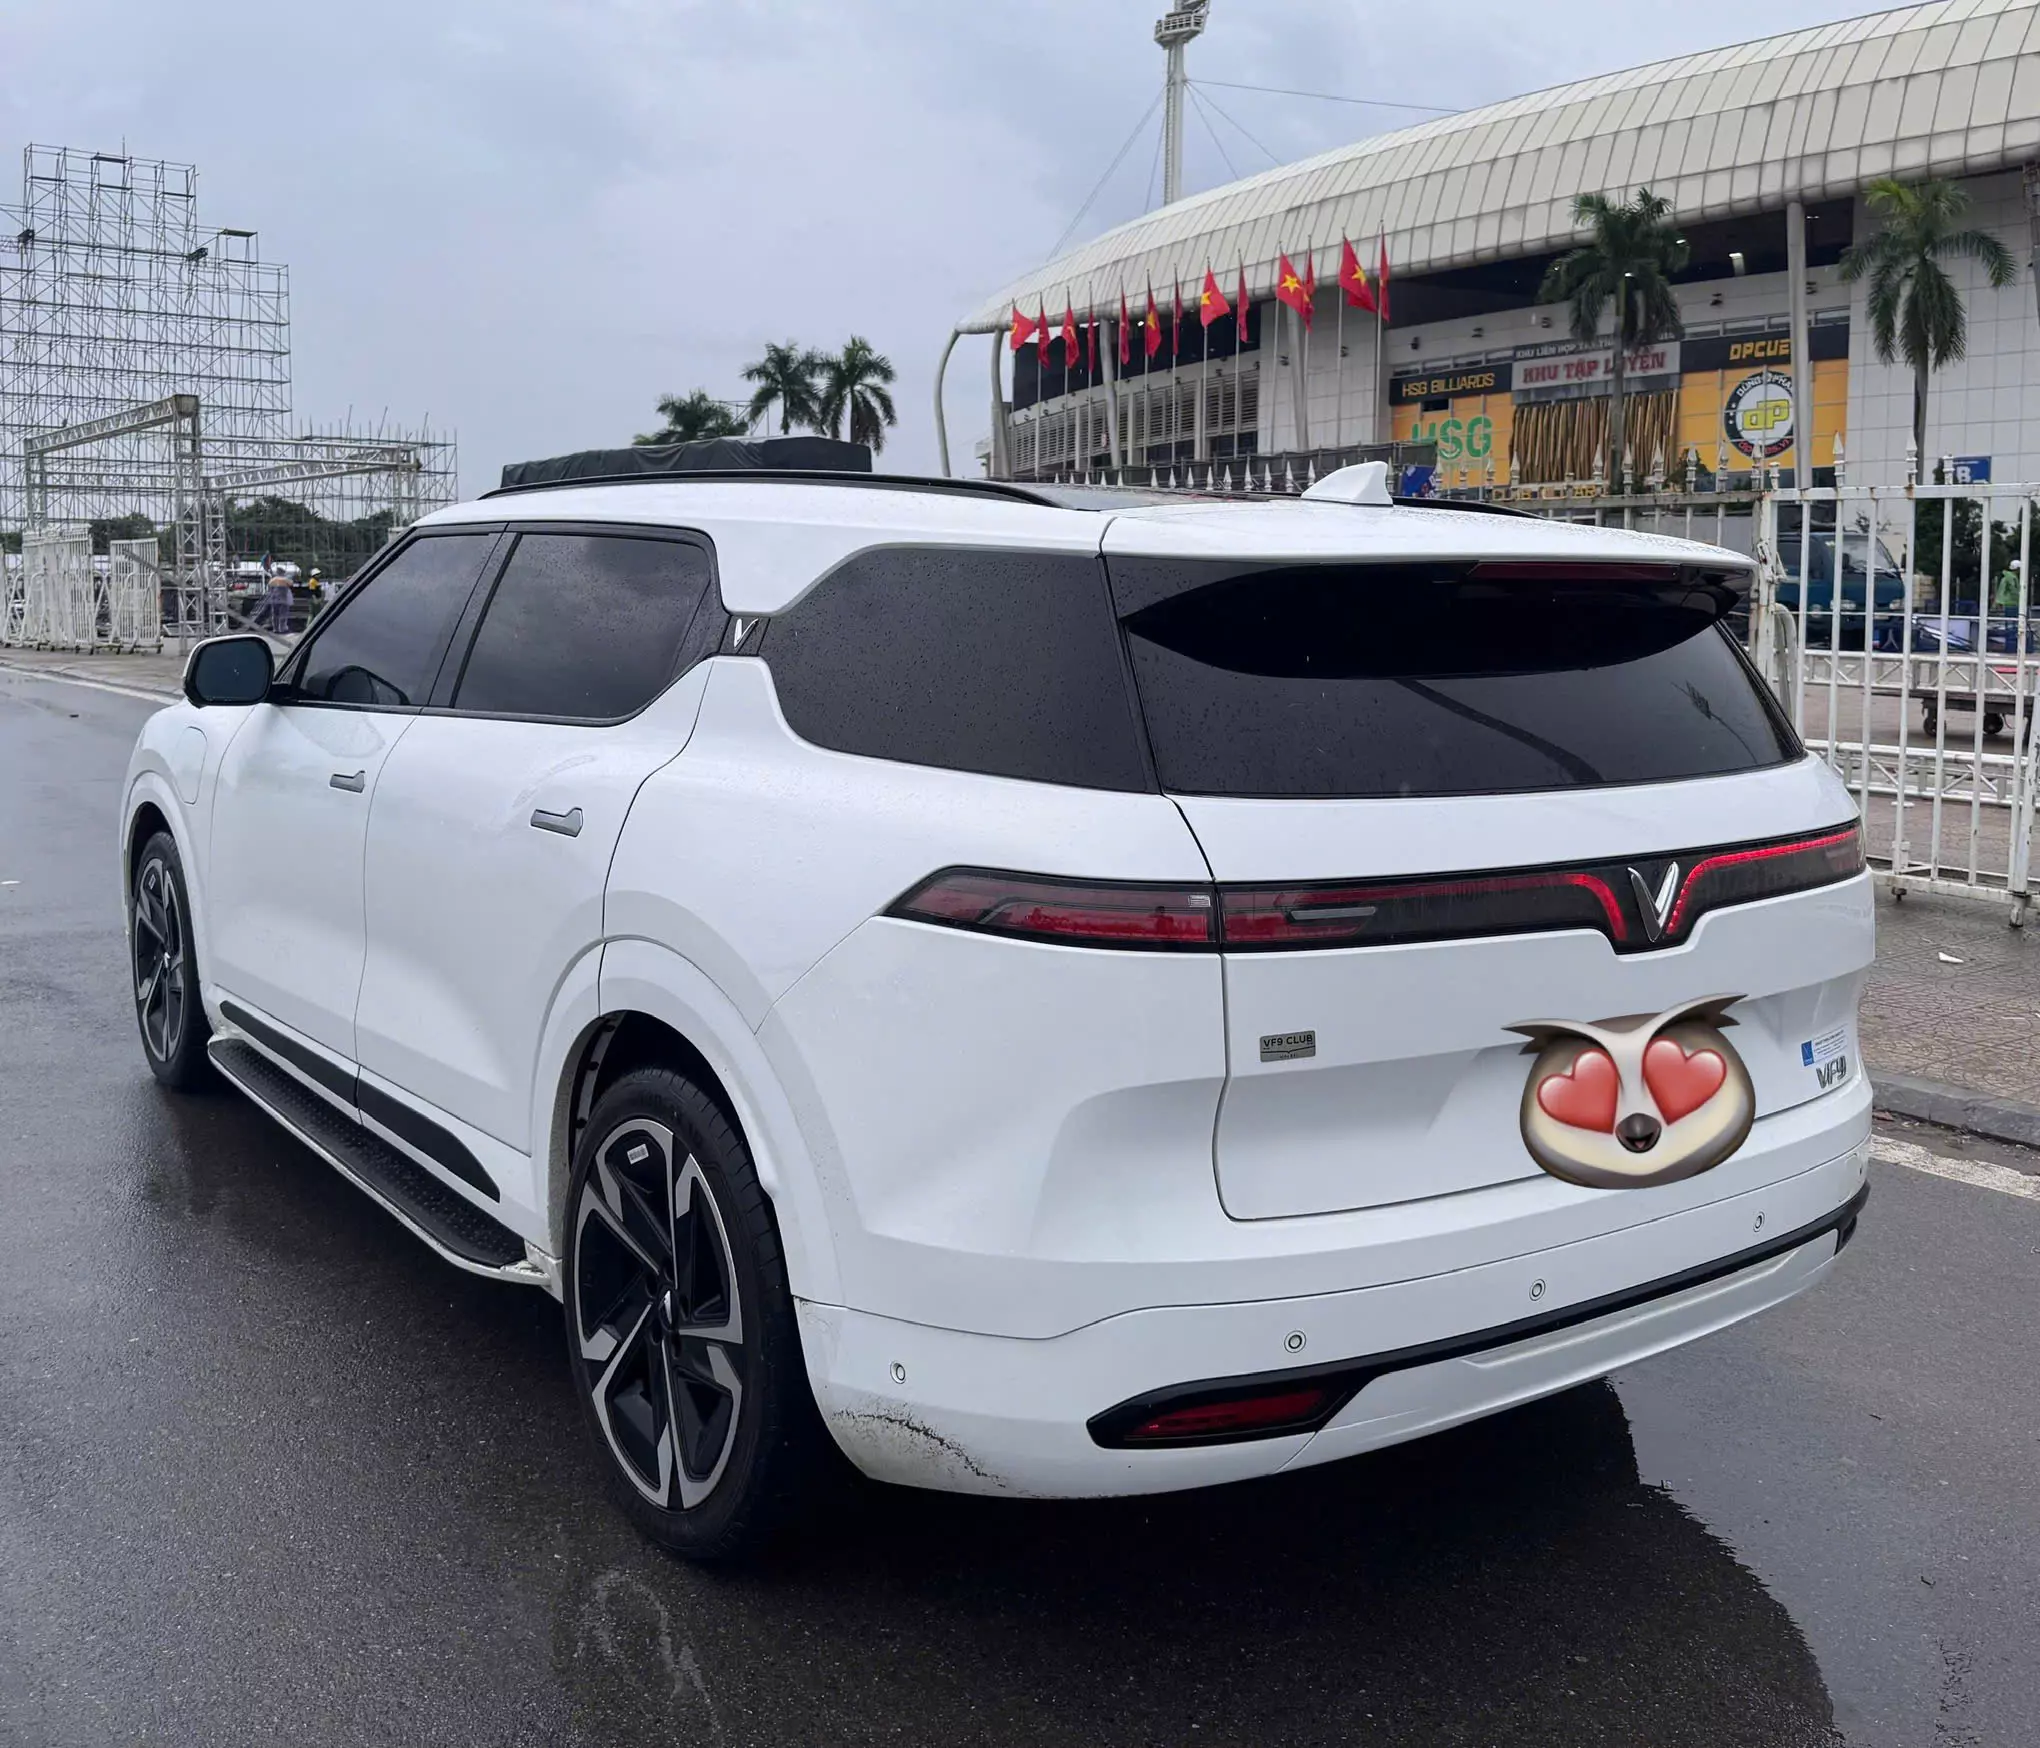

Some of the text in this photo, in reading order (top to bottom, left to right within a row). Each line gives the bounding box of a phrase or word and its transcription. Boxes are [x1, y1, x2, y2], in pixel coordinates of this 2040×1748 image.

[1523, 348, 1667, 383] KHU TẬP LYỆN
[1402, 372, 1496, 397] HSG BILLIARDS
[1263, 1034, 1313, 1048] VF9 CLUB
